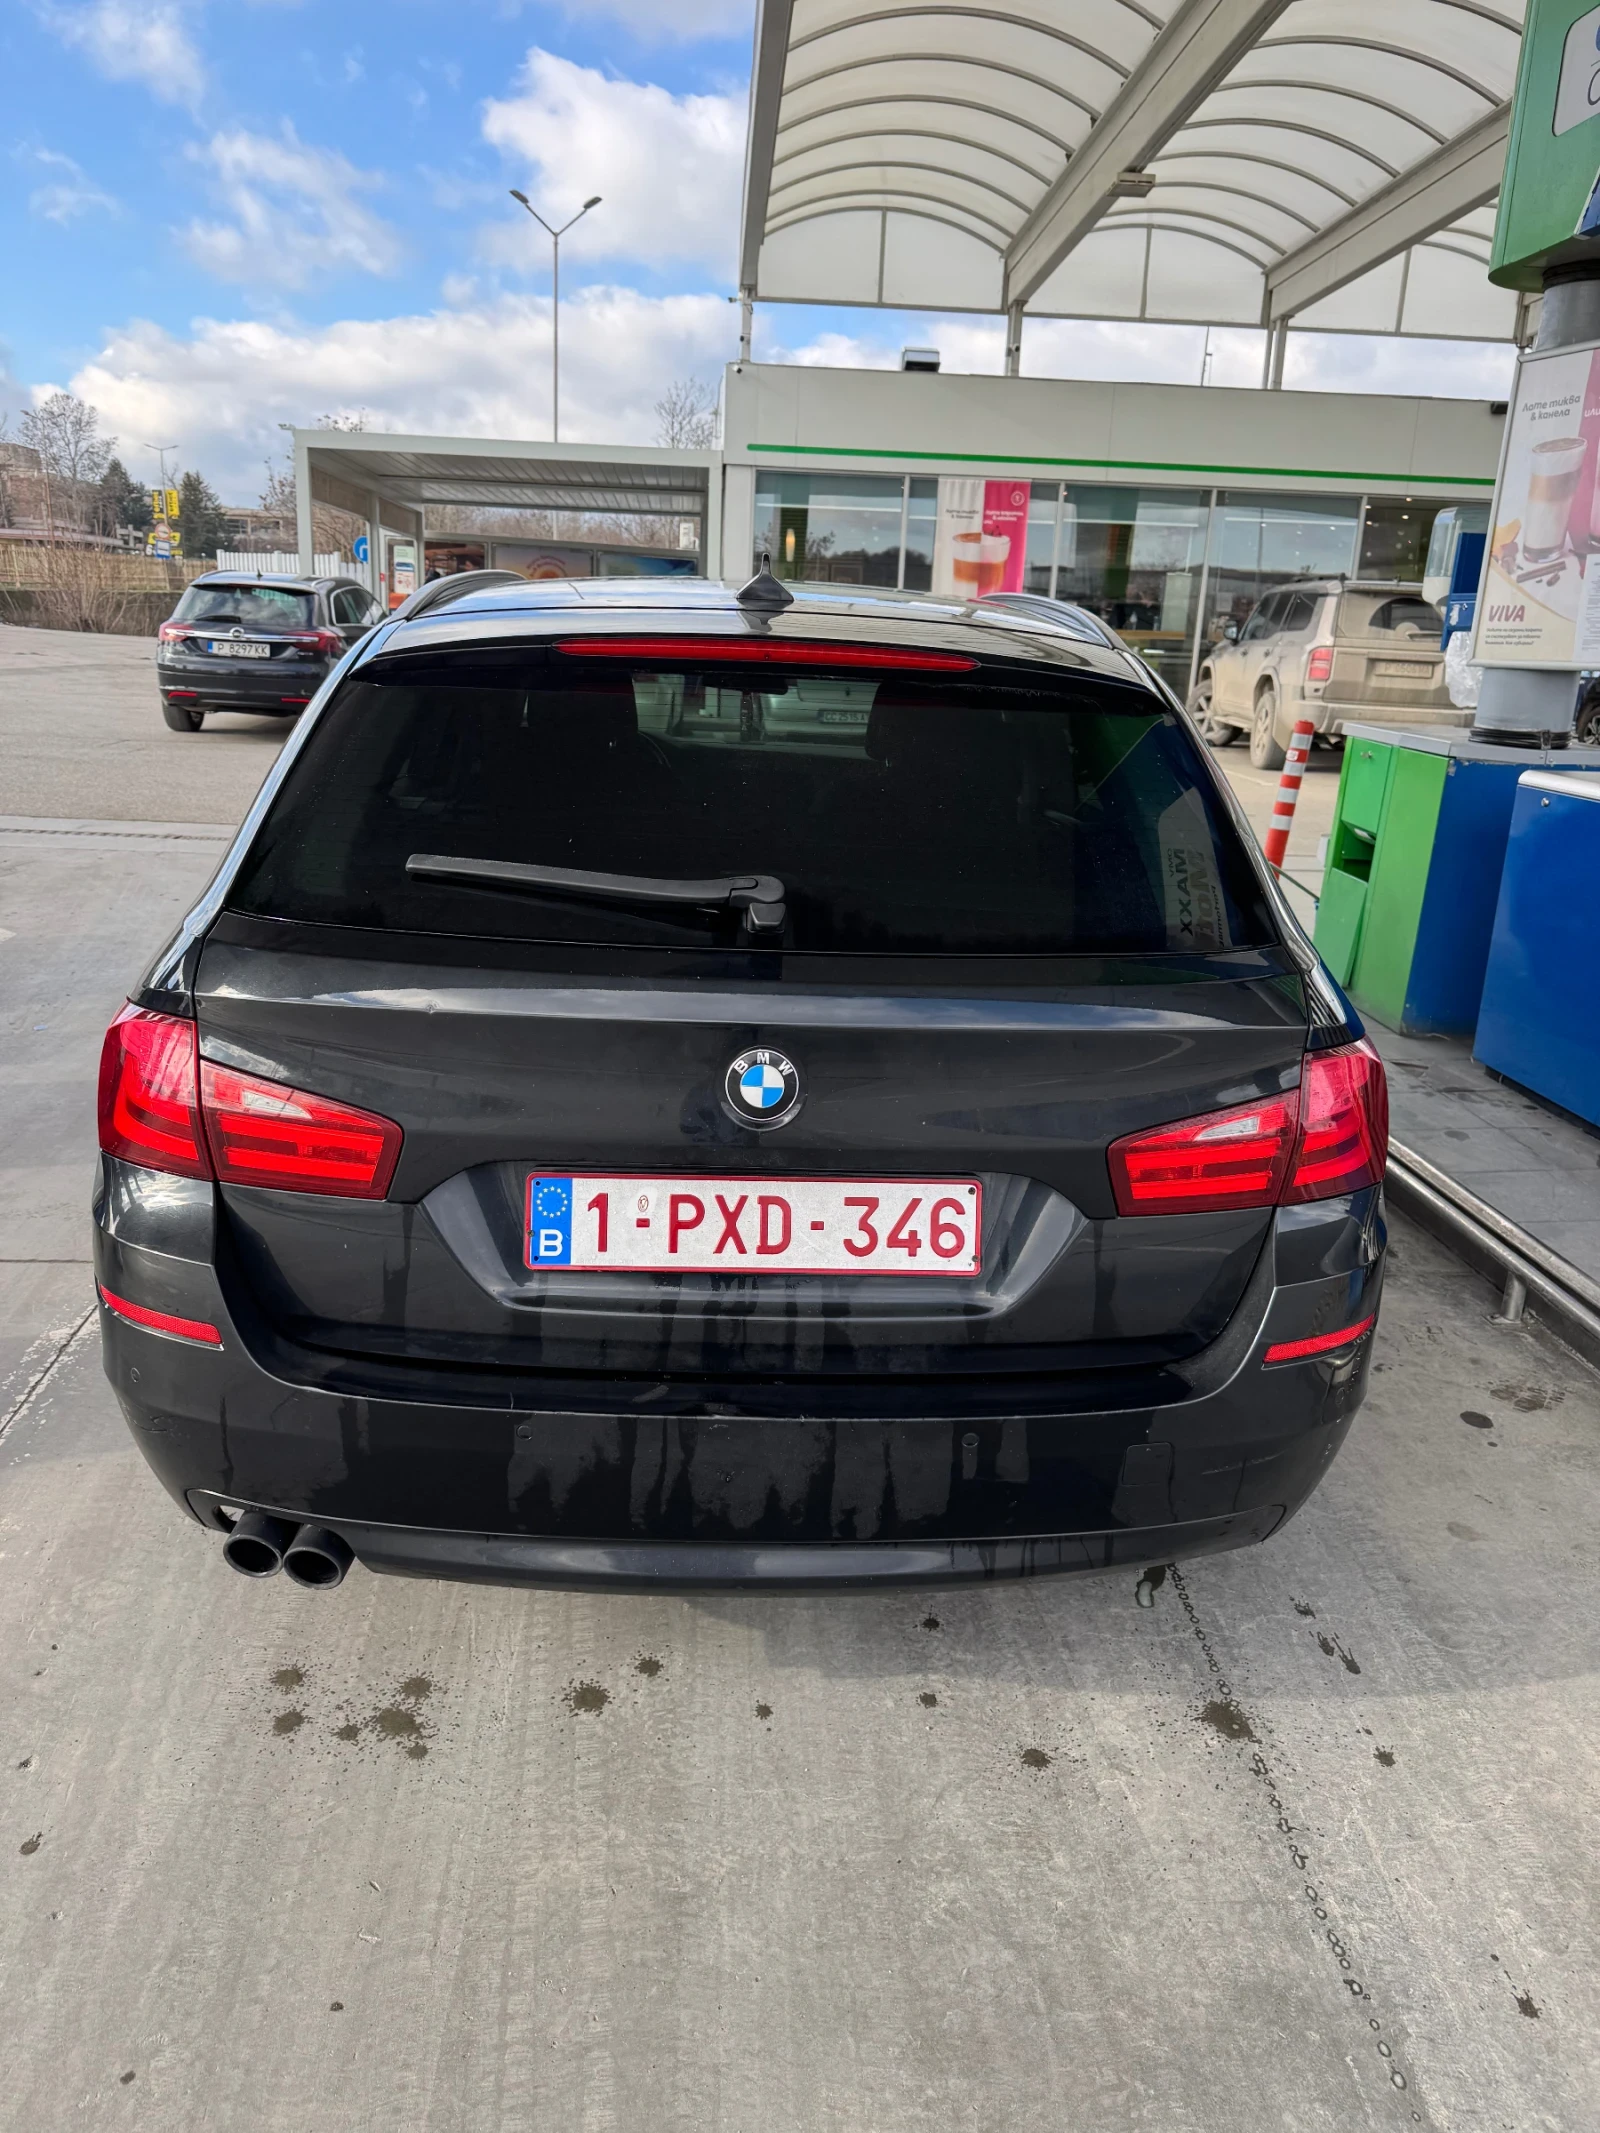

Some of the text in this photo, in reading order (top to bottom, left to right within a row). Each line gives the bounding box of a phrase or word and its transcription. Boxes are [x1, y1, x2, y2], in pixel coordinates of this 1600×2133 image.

[1488, 604, 1526, 622] VIVA
[734, 1052, 794, 1076] BMW
[587, 1192, 966, 1258] 1-PXD-346
[538, 1229, 563, 1257] B
